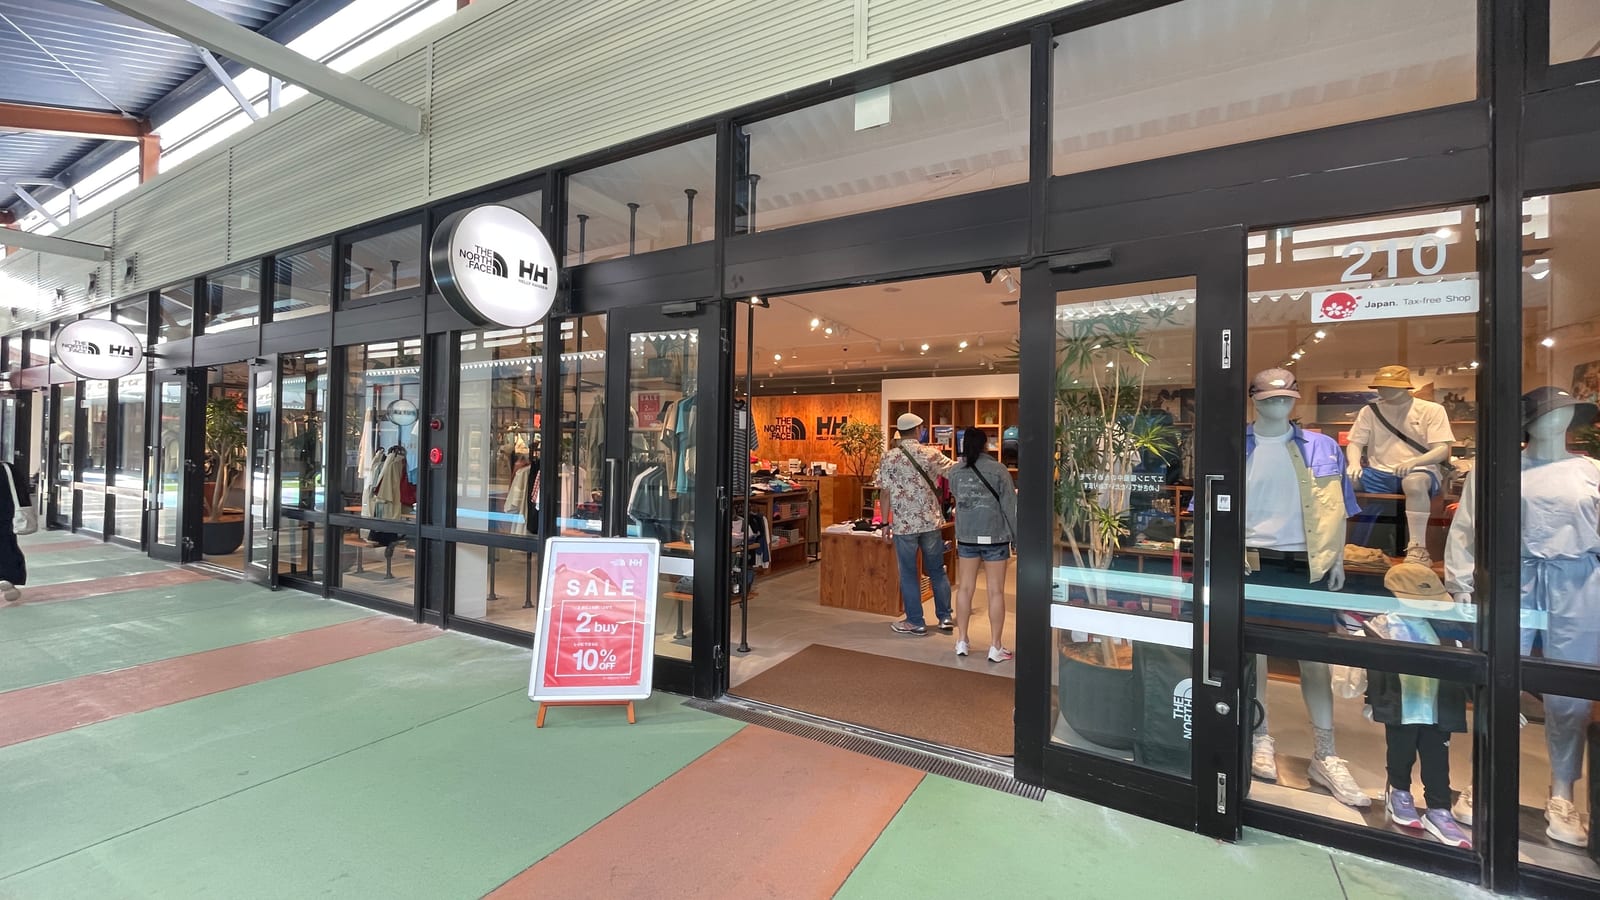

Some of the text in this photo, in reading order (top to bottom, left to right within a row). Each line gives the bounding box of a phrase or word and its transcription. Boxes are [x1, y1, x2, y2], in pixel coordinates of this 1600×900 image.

[460, 249, 492, 265] NORTH
[475, 245, 492, 257] THE
[1340, 233, 1447, 282] 210
[469, 260, 492, 274] FACE
[519, 259, 548, 285] HH
[1364, 294, 1472, 309] Japan. Tax-free Shop
[109, 344, 133, 356] HH
[763, 424, 792, 433] NORTH
[776, 417, 792, 425] THE
[816, 416, 847, 435] HH
[771, 432, 792, 440] FACE
[567, 579, 634, 596] SALE
[575, 611, 619, 635] 2 buy
[598, 662, 616, 670] OFF
[1173, 696, 1184, 719] THE
[1183, 697, 1192, 739] NORTH
